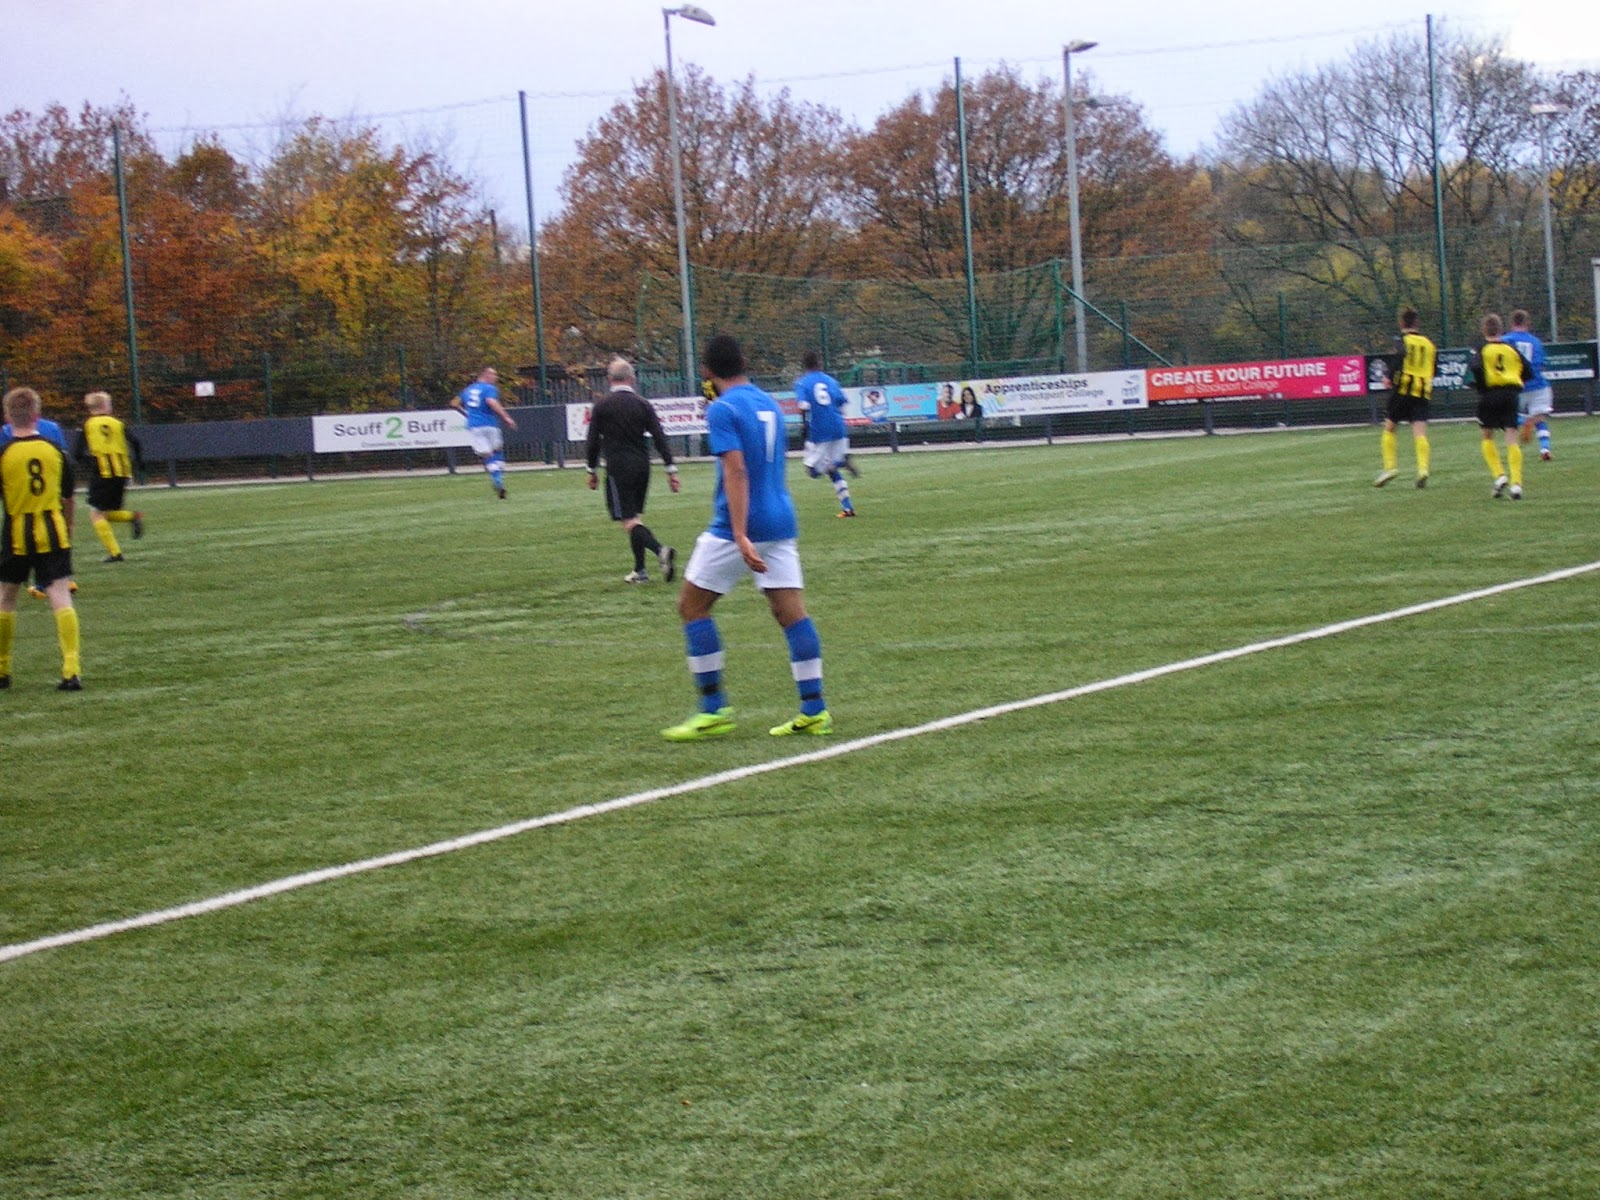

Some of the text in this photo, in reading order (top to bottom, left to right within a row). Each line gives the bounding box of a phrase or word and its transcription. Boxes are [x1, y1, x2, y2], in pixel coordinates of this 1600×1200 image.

[984, 378, 1088, 395] Apprenticeships
[1151, 370, 1213, 387] CREATE
[1216, 366, 1260, 383] YOUR
[1263, 362, 1327, 379] FUTURE
[814, 383, 831, 406] 6
[333, 422, 382, 437] Scuff
[385, 416, 404, 439] 2
[407, 419, 447, 434] Buff
[756, 410, 776, 463] 7
[28, 458, 45, 496] 8
